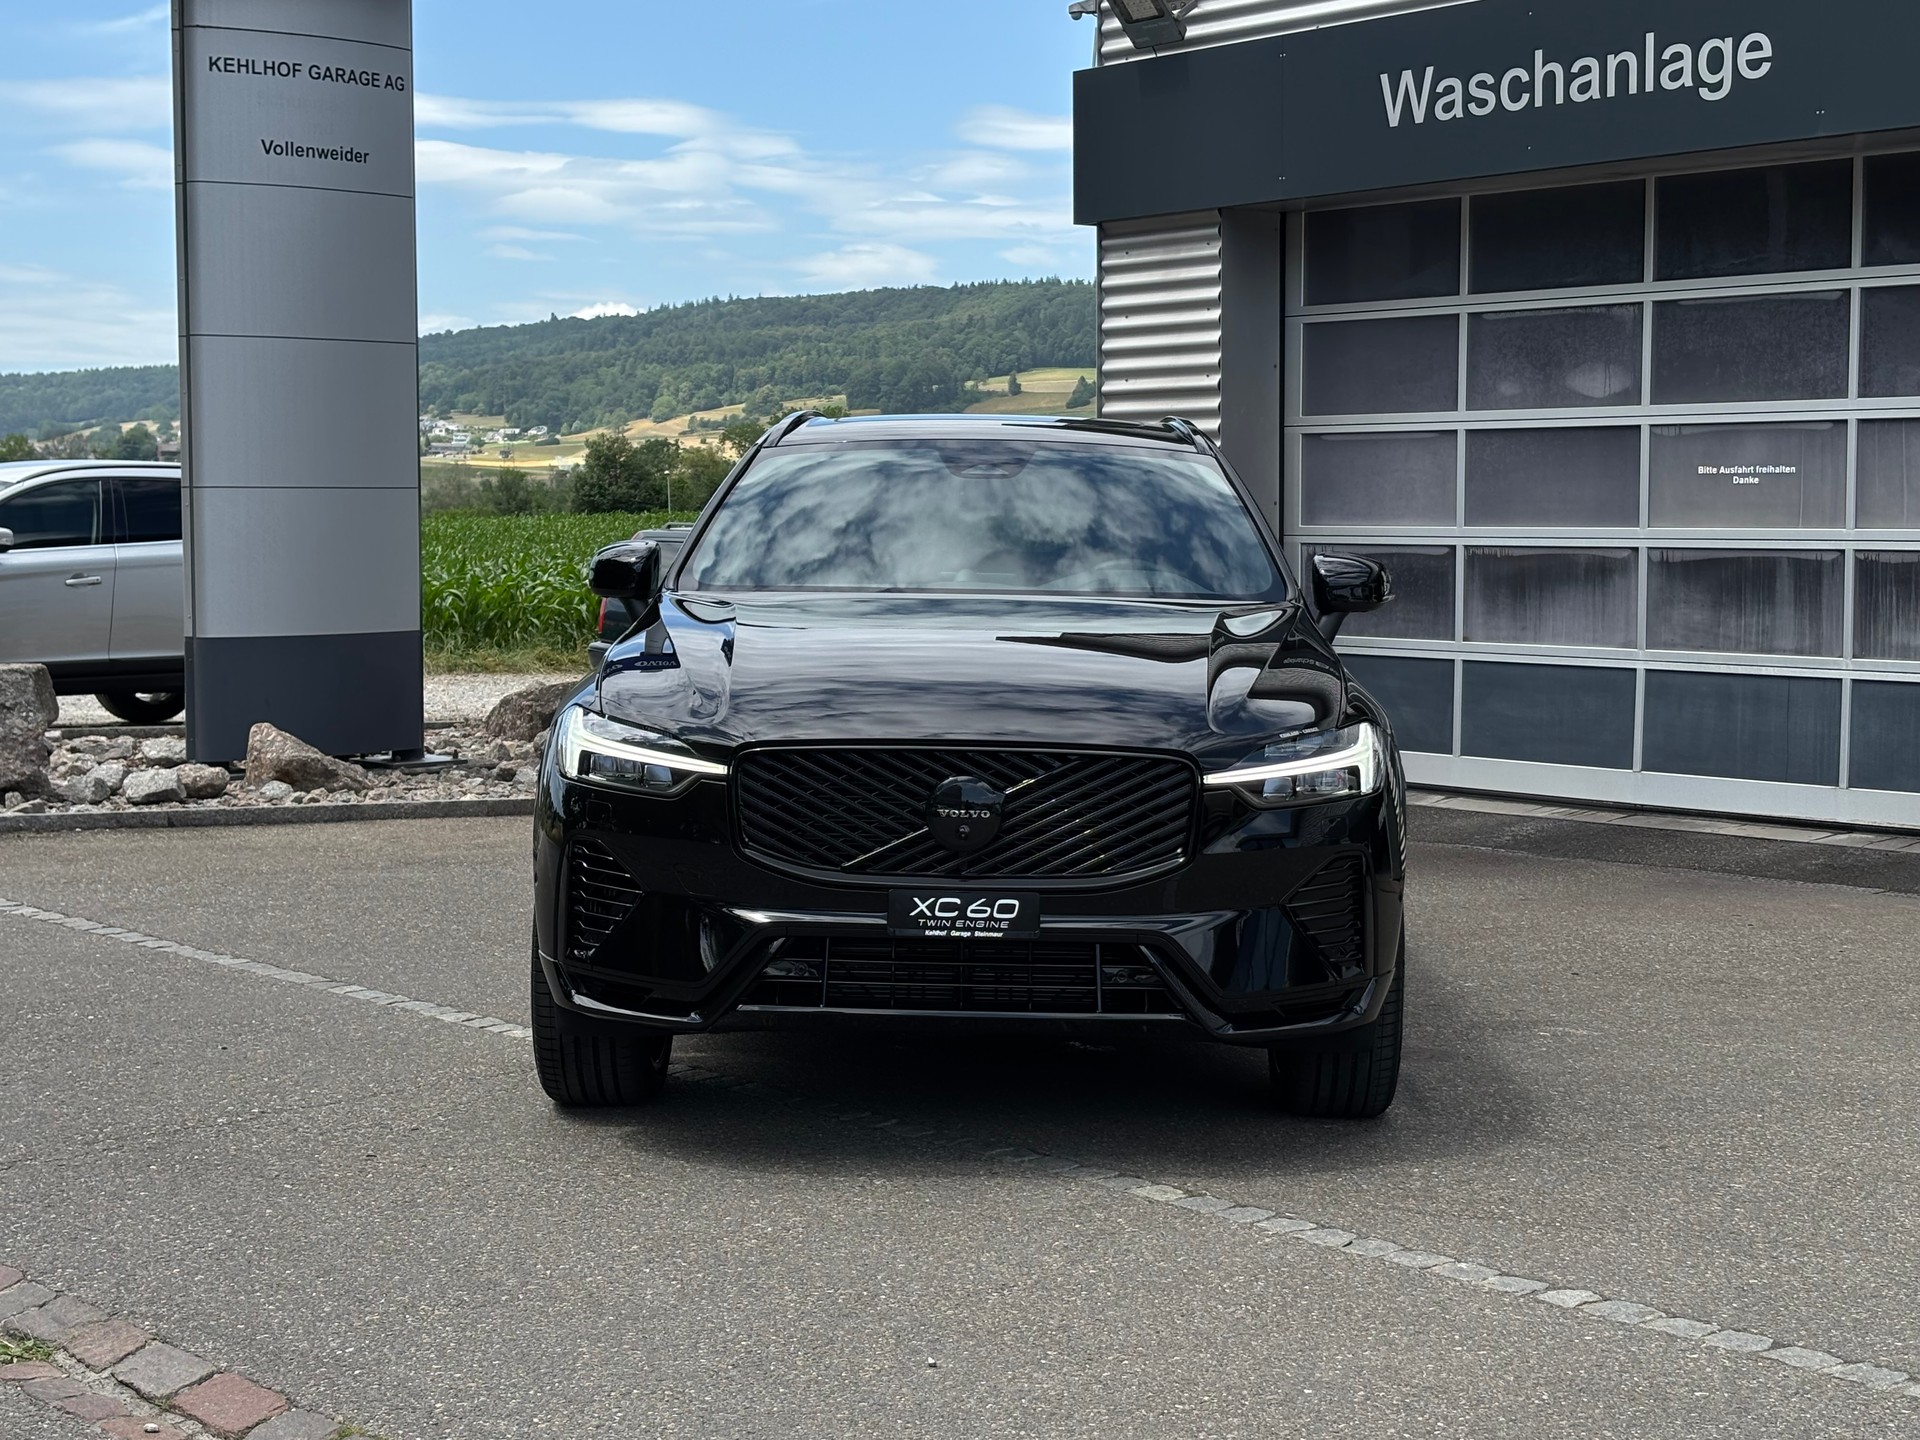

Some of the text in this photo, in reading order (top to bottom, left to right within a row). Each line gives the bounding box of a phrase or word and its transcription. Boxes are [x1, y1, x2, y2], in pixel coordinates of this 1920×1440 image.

[208, 56, 405, 92] KEHLHOF GARAGE AG
[1379, 31, 1773, 128] Waschanlage
[261, 139, 370, 164] Vollenweider
[1697, 465, 1796, 474] Bitte Ausfahrt freihalten
[1732, 475, 1760, 484] Danke
[936, 809, 991, 819] VOLVO
[909, 897, 1020, 919] XC 60
[918, 919, 1010, 929] TWIN ENGINE
[950, 930, 972, 938] Garage
